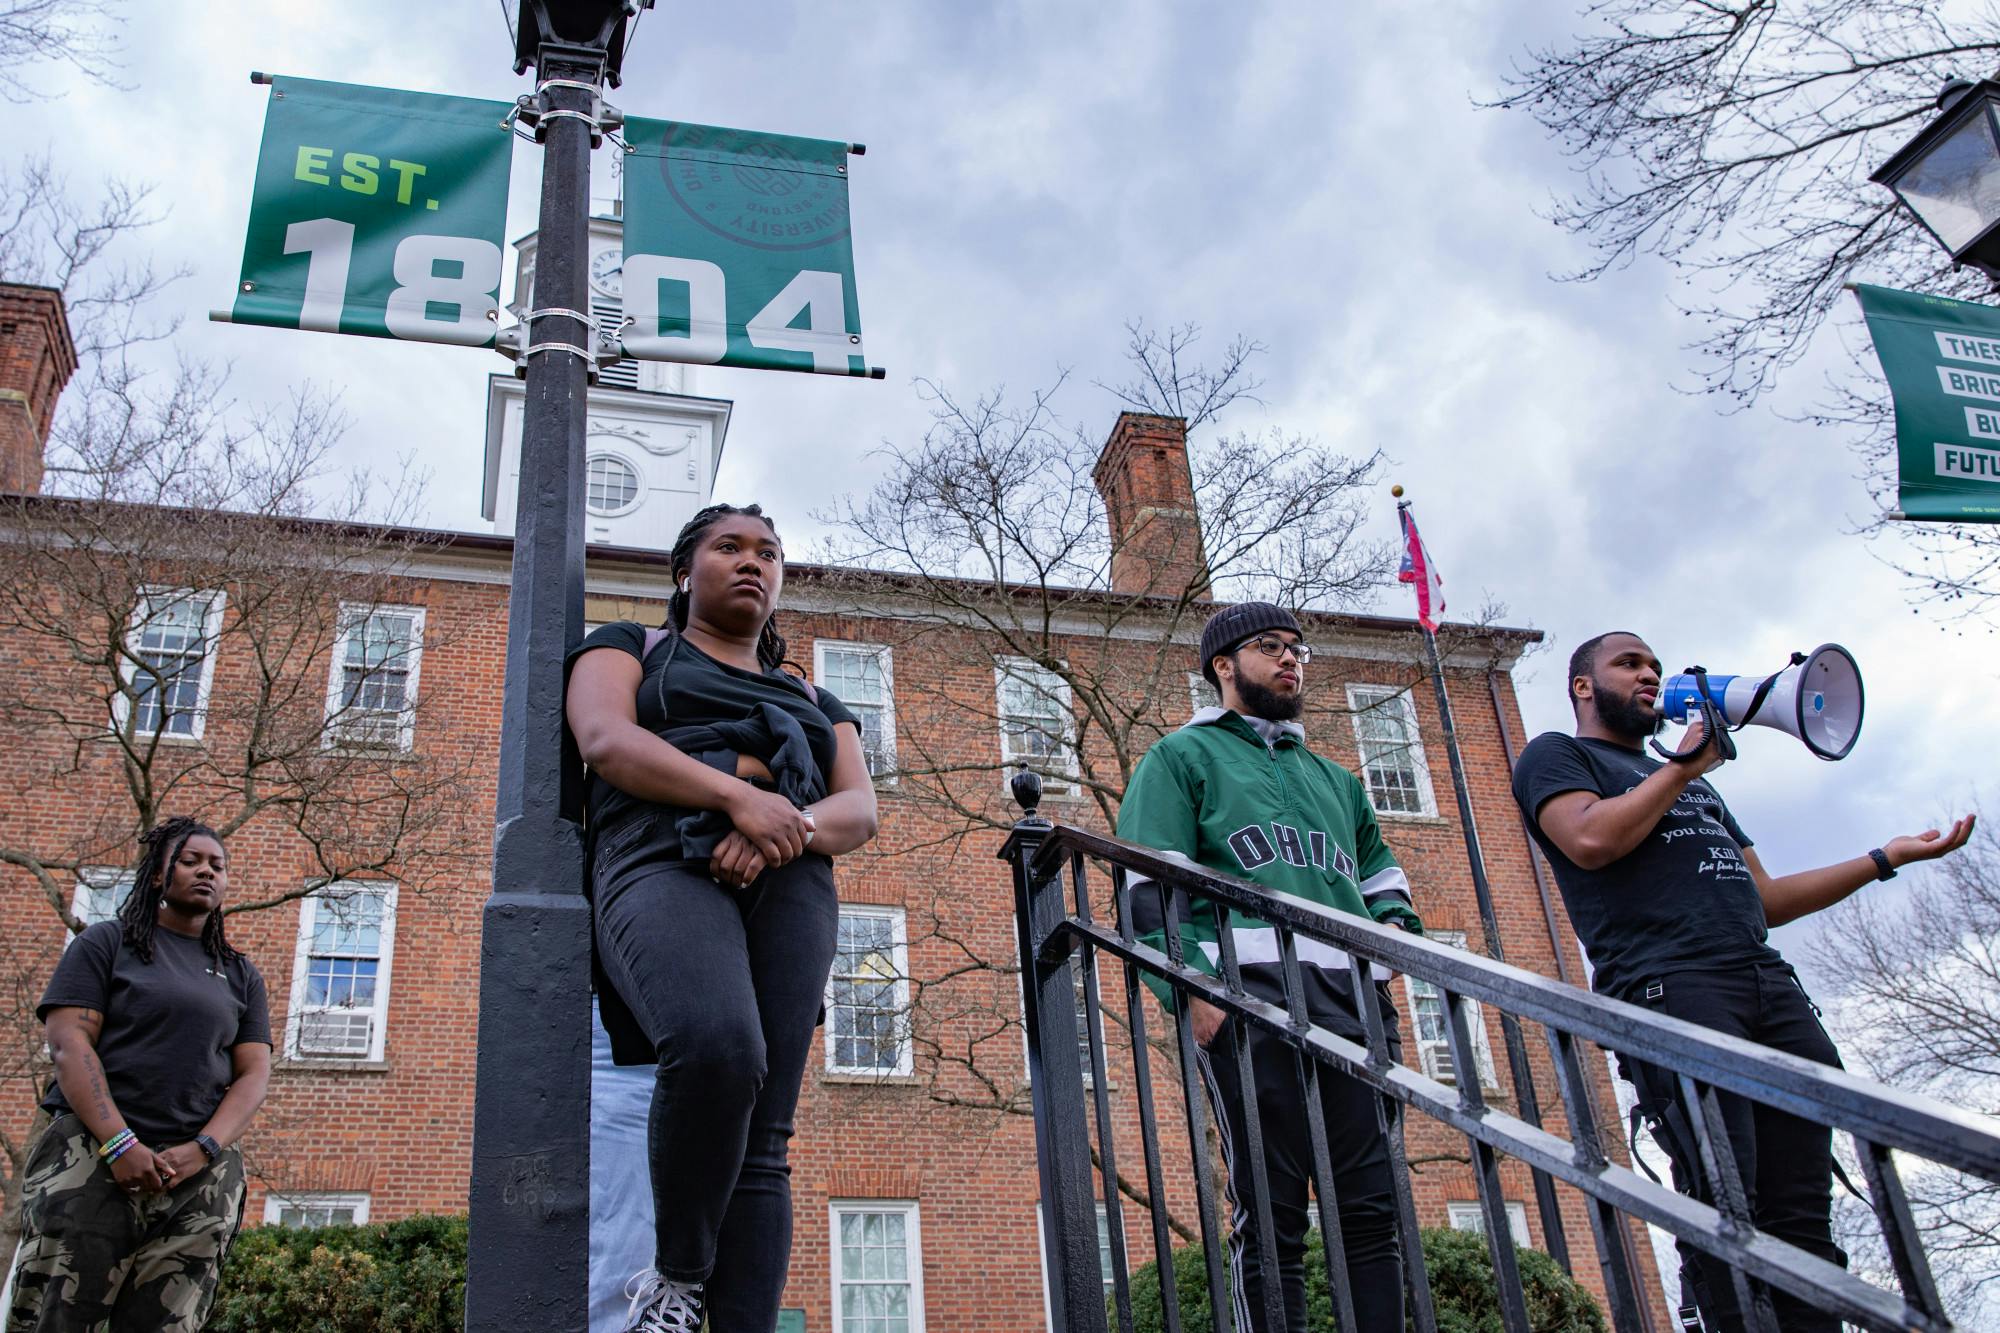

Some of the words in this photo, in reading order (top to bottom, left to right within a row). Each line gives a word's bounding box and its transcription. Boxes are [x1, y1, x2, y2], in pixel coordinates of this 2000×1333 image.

[294, 146, 439, 210] EST.
[1945, 337, 2000, 361] THES
[1948, 372, 2000, 397] BRIC
[1661, 827, 1696, 844] you
